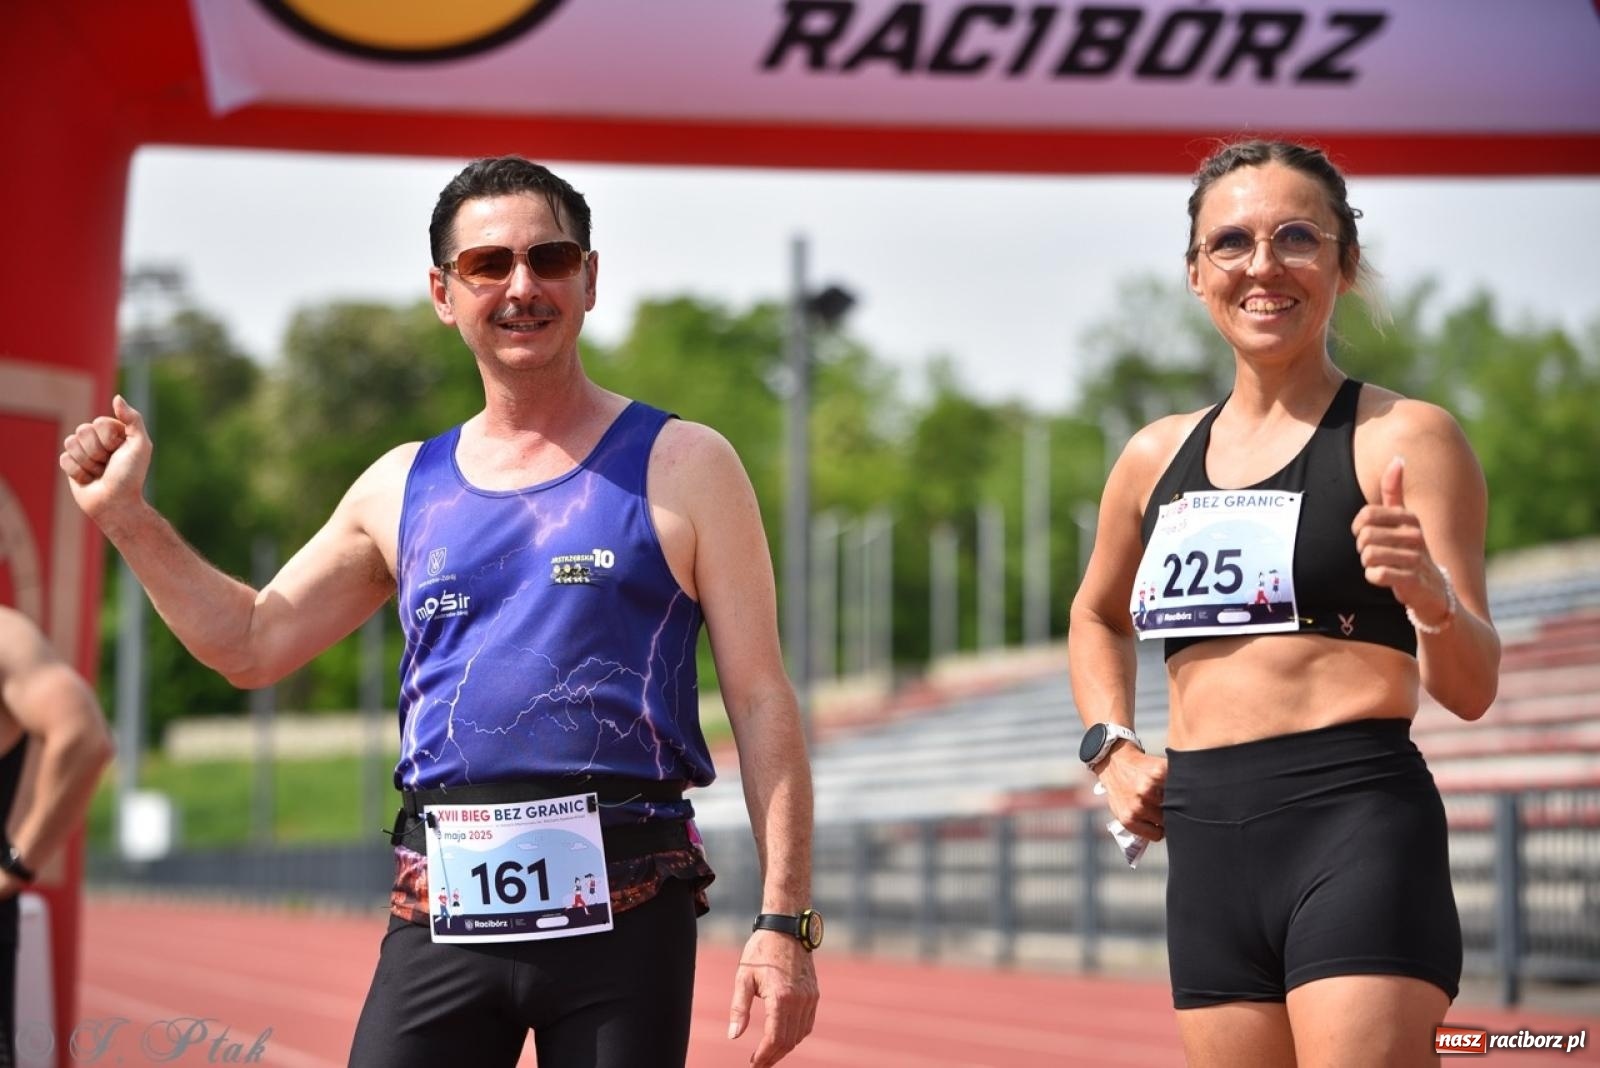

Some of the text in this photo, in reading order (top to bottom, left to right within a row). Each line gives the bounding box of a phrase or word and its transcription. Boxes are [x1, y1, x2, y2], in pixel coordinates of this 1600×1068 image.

[1192, 497, 1220, 509] BEZ
[1224, 495, 1285, 508] GRANIC
[592, 548, 615, 569] 10
[1162, 549, 1244, 599] 225
[438, 810, 459, 823] XVII
[461, 809, 491, 822] BIEG
[494, 807, 522, 822] BEZ
[526, 800, 585, 818] GRANIC
[444, 832, 467, 842] maja
[469, 830, 493, 841] 2025
[471, 857, 550, 905] 161
[474, 919, 509, 929] Racibórz
